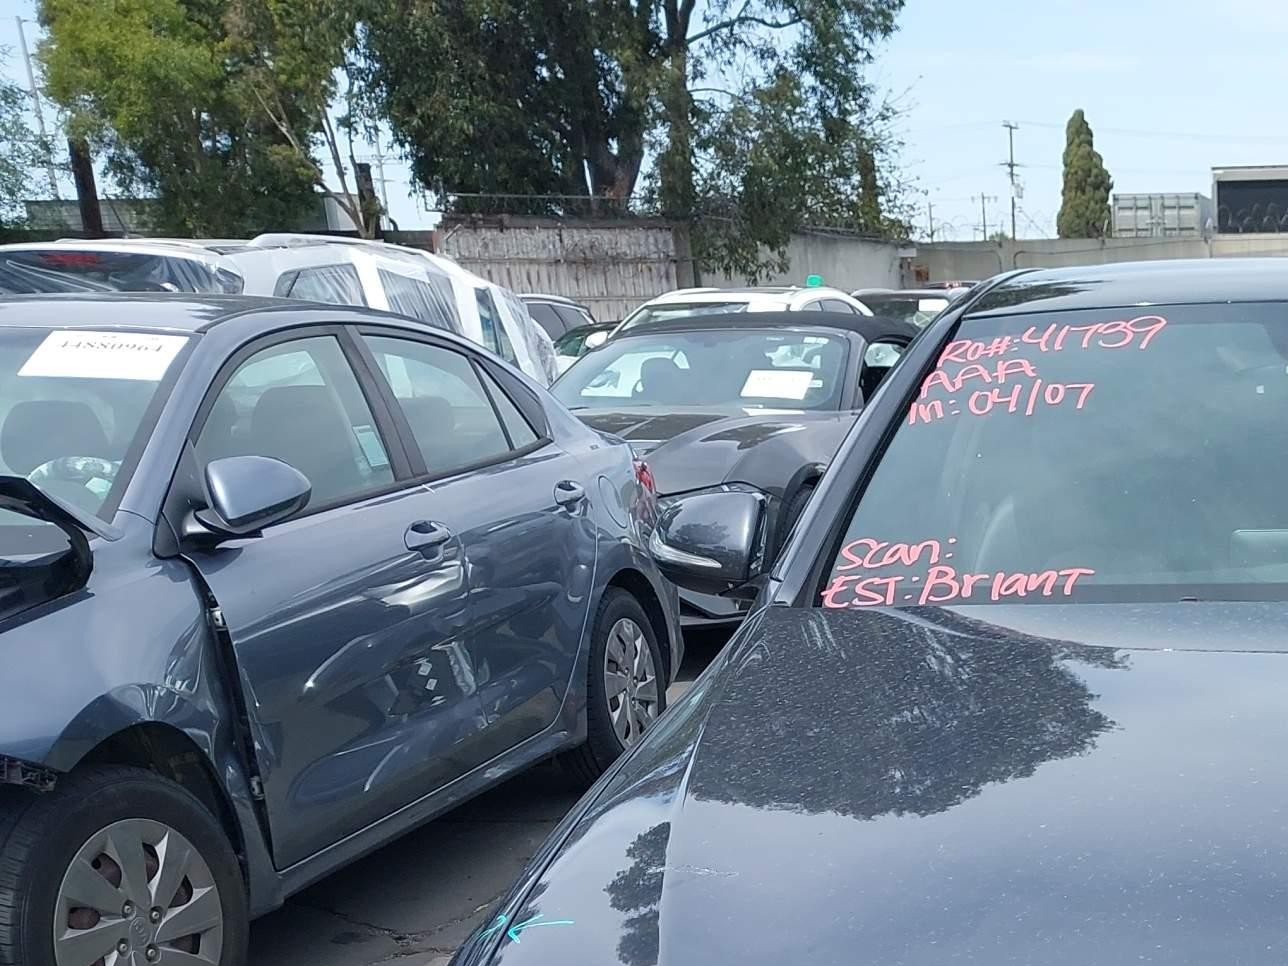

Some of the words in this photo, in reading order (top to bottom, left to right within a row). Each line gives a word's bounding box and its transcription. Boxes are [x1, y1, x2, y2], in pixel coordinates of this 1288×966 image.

[920, 358, 1037, 399] AAA
[968, 379, 1095, 417] 04/07
[836, 538, 957, 571] Scan:
